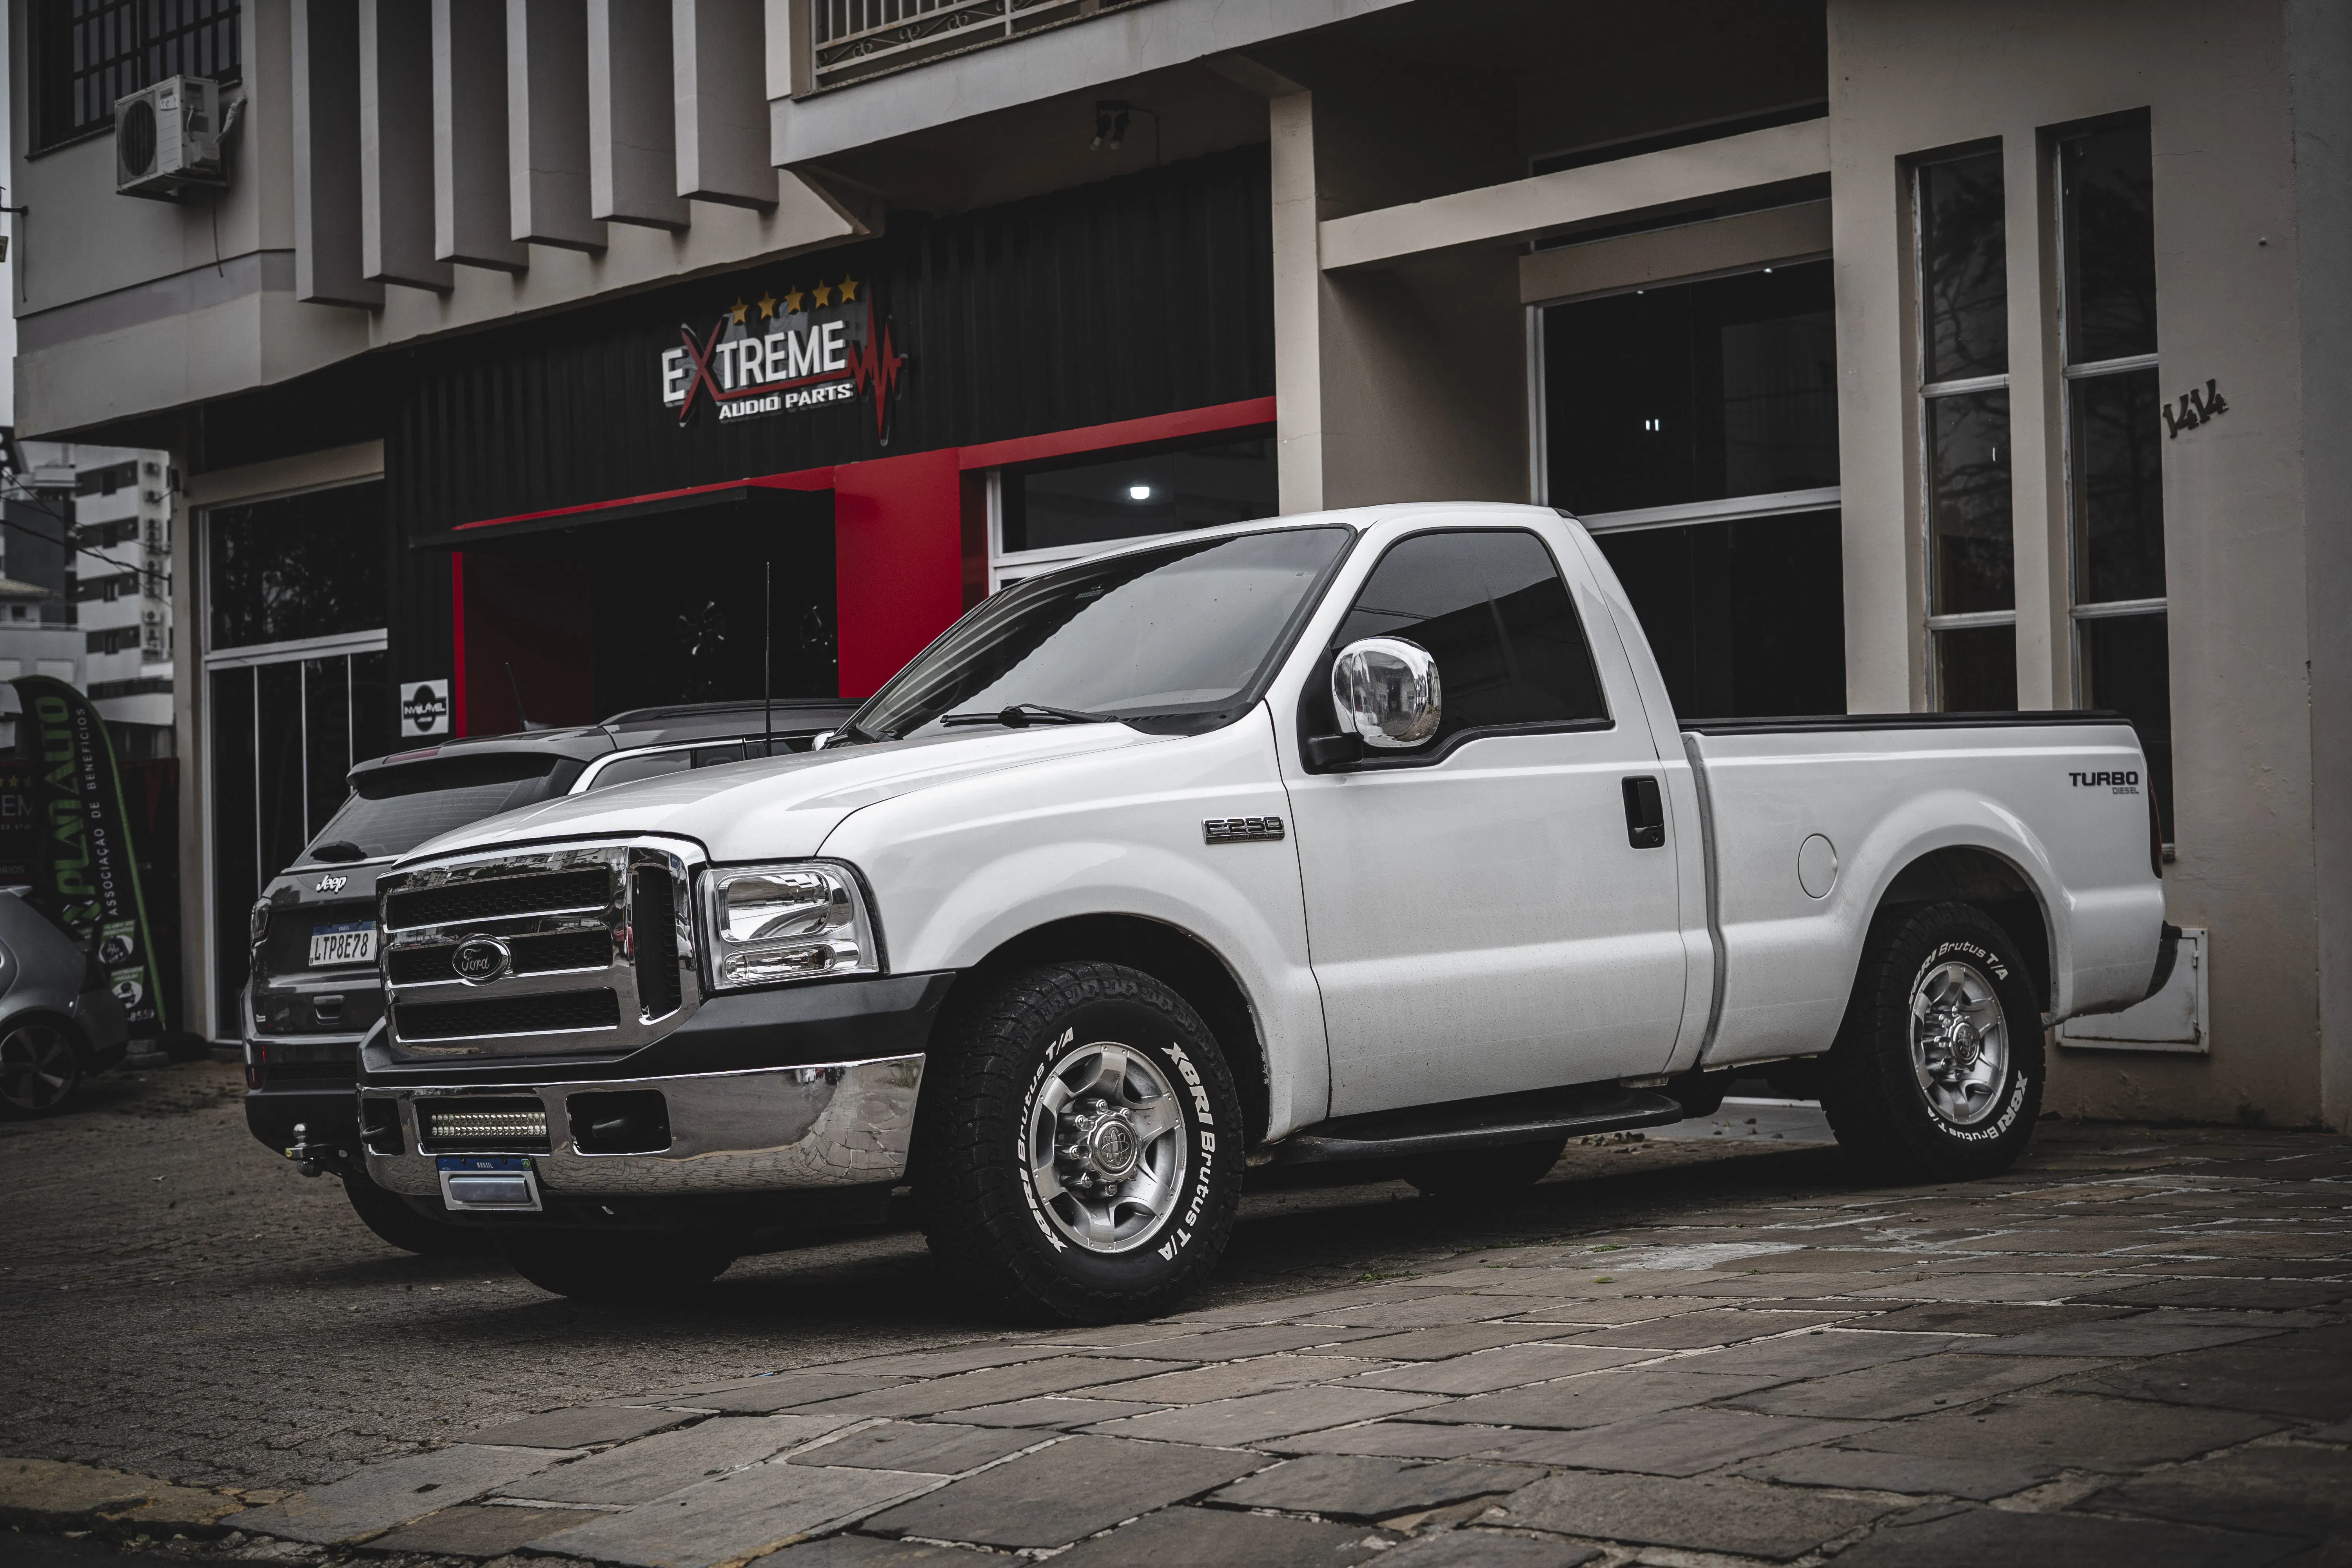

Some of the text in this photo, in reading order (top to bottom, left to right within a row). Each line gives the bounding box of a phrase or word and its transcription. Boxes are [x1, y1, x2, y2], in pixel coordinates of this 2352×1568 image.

[661, 316, 847, 421] EXTREME
[719, 383, 851, 419] AUDIO PARTS
[2068, 771, 2138, 787] TURBO
[2112, 786, 2139, 795] DIESEL
[89, 801, 102, 818] DE
[316, 875, 347, 893] Jeep
[314, 933, 369, 960] LTP8E78
[462, 948, 490, 971] Ford
[1938, 942, 1986, 958] Brutus
[1986, 953, 2008, 980] T/A
[1997, 1069, 2028, 1133] XBRI
[1018, 1027, 1074, 1253] XBRI Brutus T/A
[1949, 1125, 1999, 1142] Brutus
[1158, 1042, 1216, 1261] XBRI Brutus T/A
